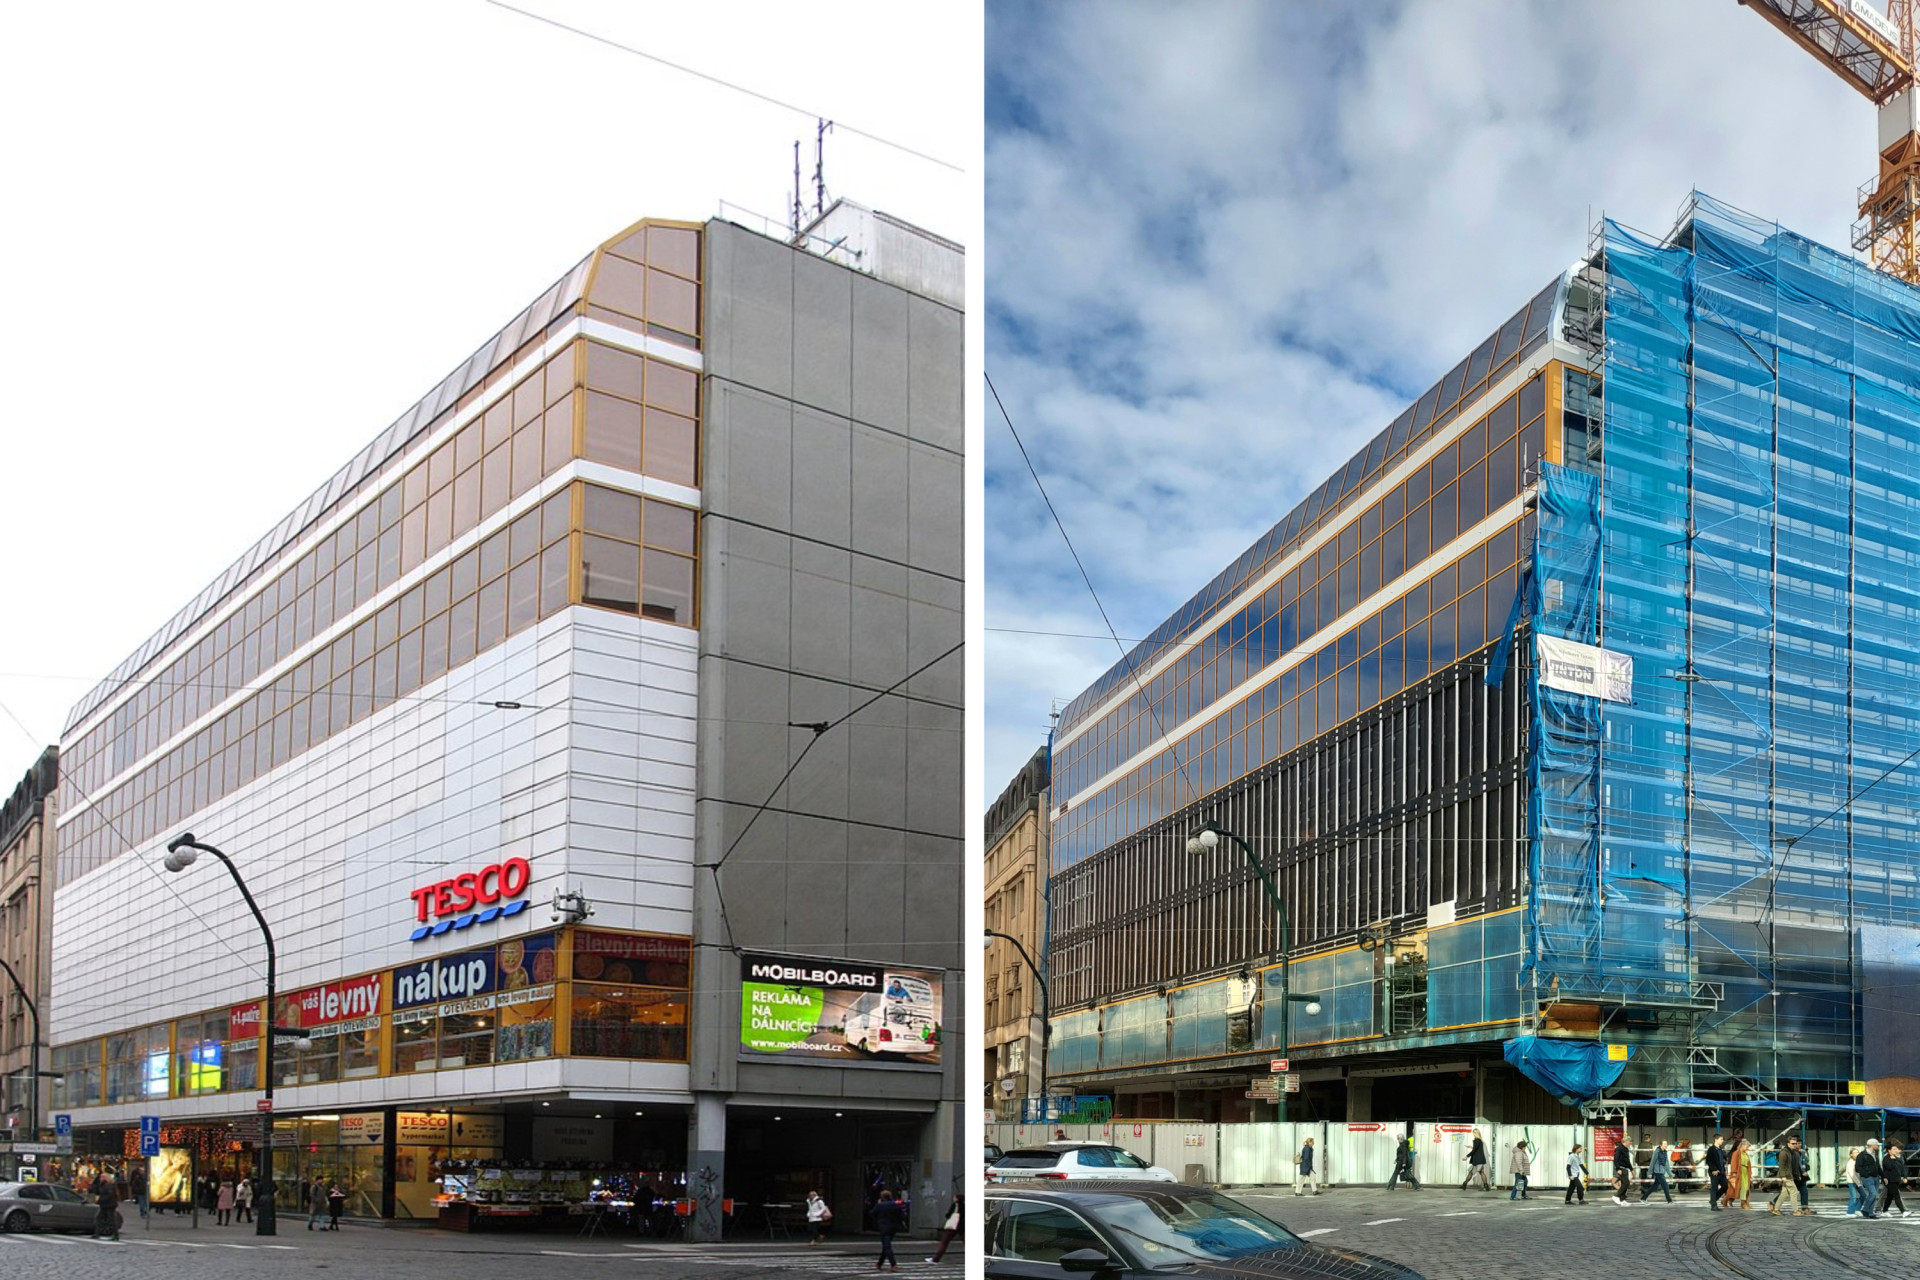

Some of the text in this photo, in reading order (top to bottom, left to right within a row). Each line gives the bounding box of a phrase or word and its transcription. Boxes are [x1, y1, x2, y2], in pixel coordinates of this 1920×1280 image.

[1854, 1, 1898, 41] AMADEUS
[411, 857, 531, 922] TESCO
[398, 957, 487, 1005] nákup
[751, 964, 876, 987] MOBILBOARD
[302, 973, 381, 1020] váš levný
[752, 990, 811, 1007] REKLAMA
[444, 998, 490, 1015] OTEVŘENO
[752, 1004, 771, 1017] NA
[751, 1016, 818, 1034] DÁLNICÍCH
[750, 1038, 842, 1053] www.mobilboard.cz
[58, 1117, 68, 1129] P
[341, 1117, 364, 1127] TESCO
[400, 1116, 447, 1127] TESCO
[144, 1136, 156, 1149] P
